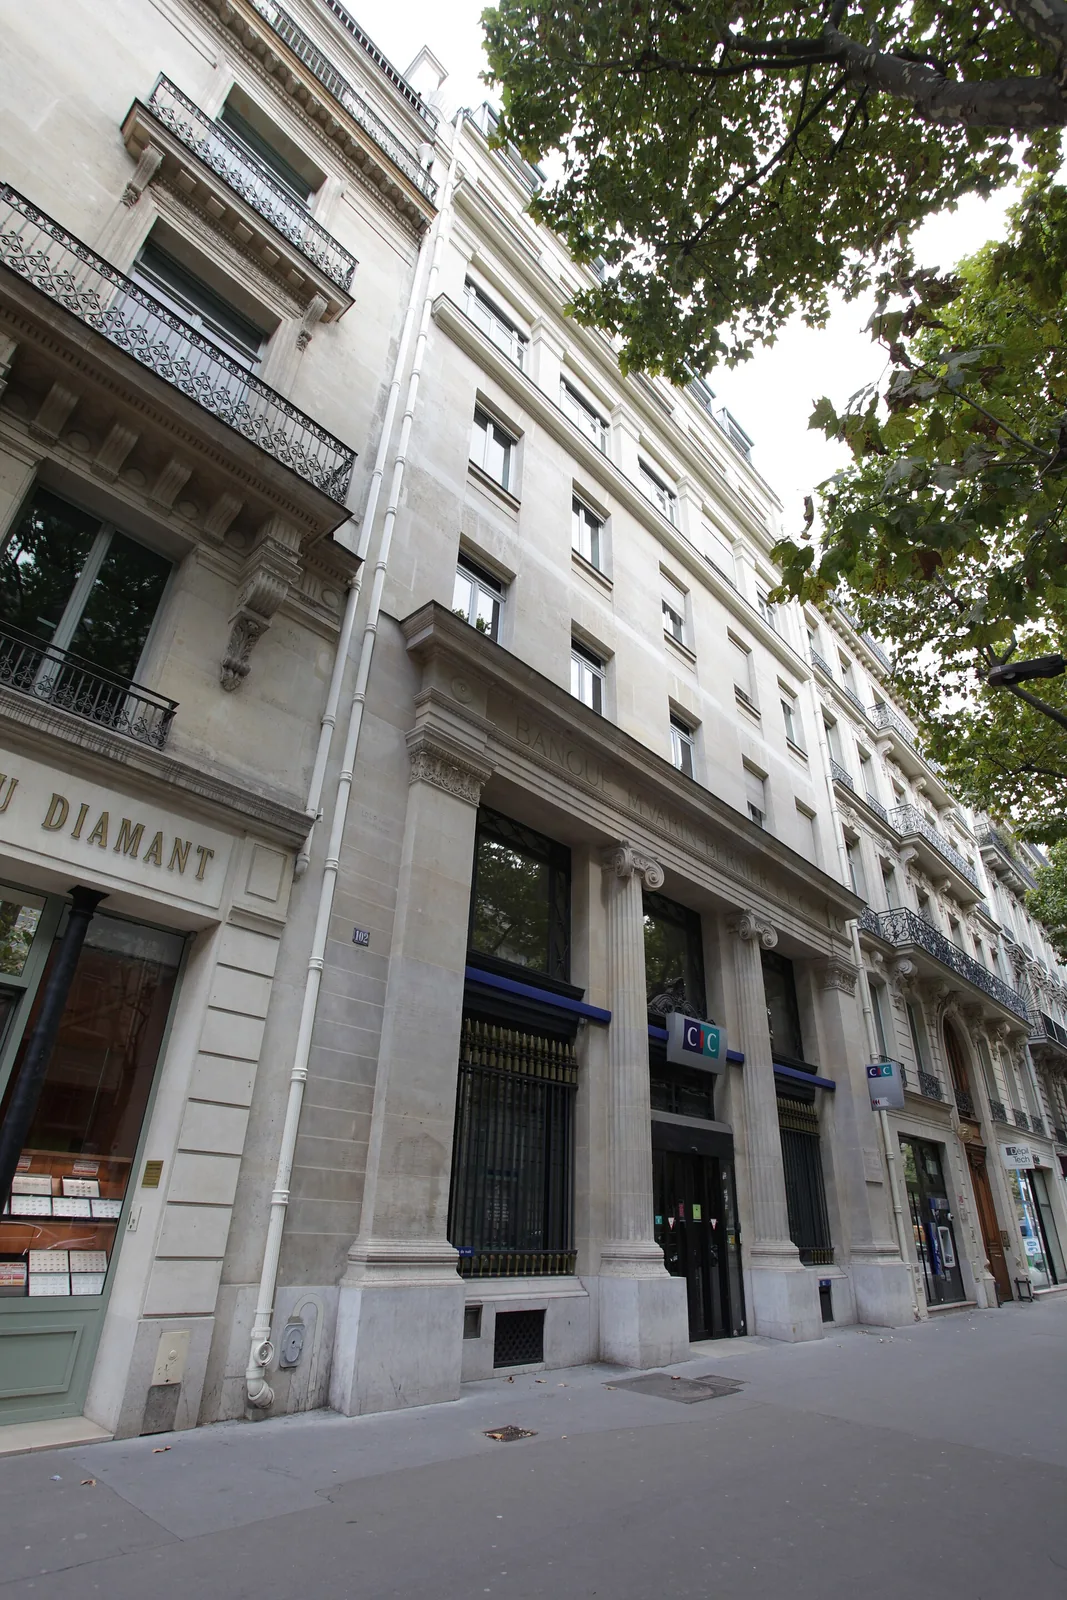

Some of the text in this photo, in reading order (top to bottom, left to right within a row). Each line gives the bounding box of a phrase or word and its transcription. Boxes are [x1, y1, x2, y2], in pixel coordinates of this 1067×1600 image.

[516, 715, 613, 798] BANQUE
[41, 792, 215, 880] DIAMANT
[355, 930, 369, 944] 102
[687, 1026, 717, 1053] CIC
[869, 1066, 892, 1078] CIC
